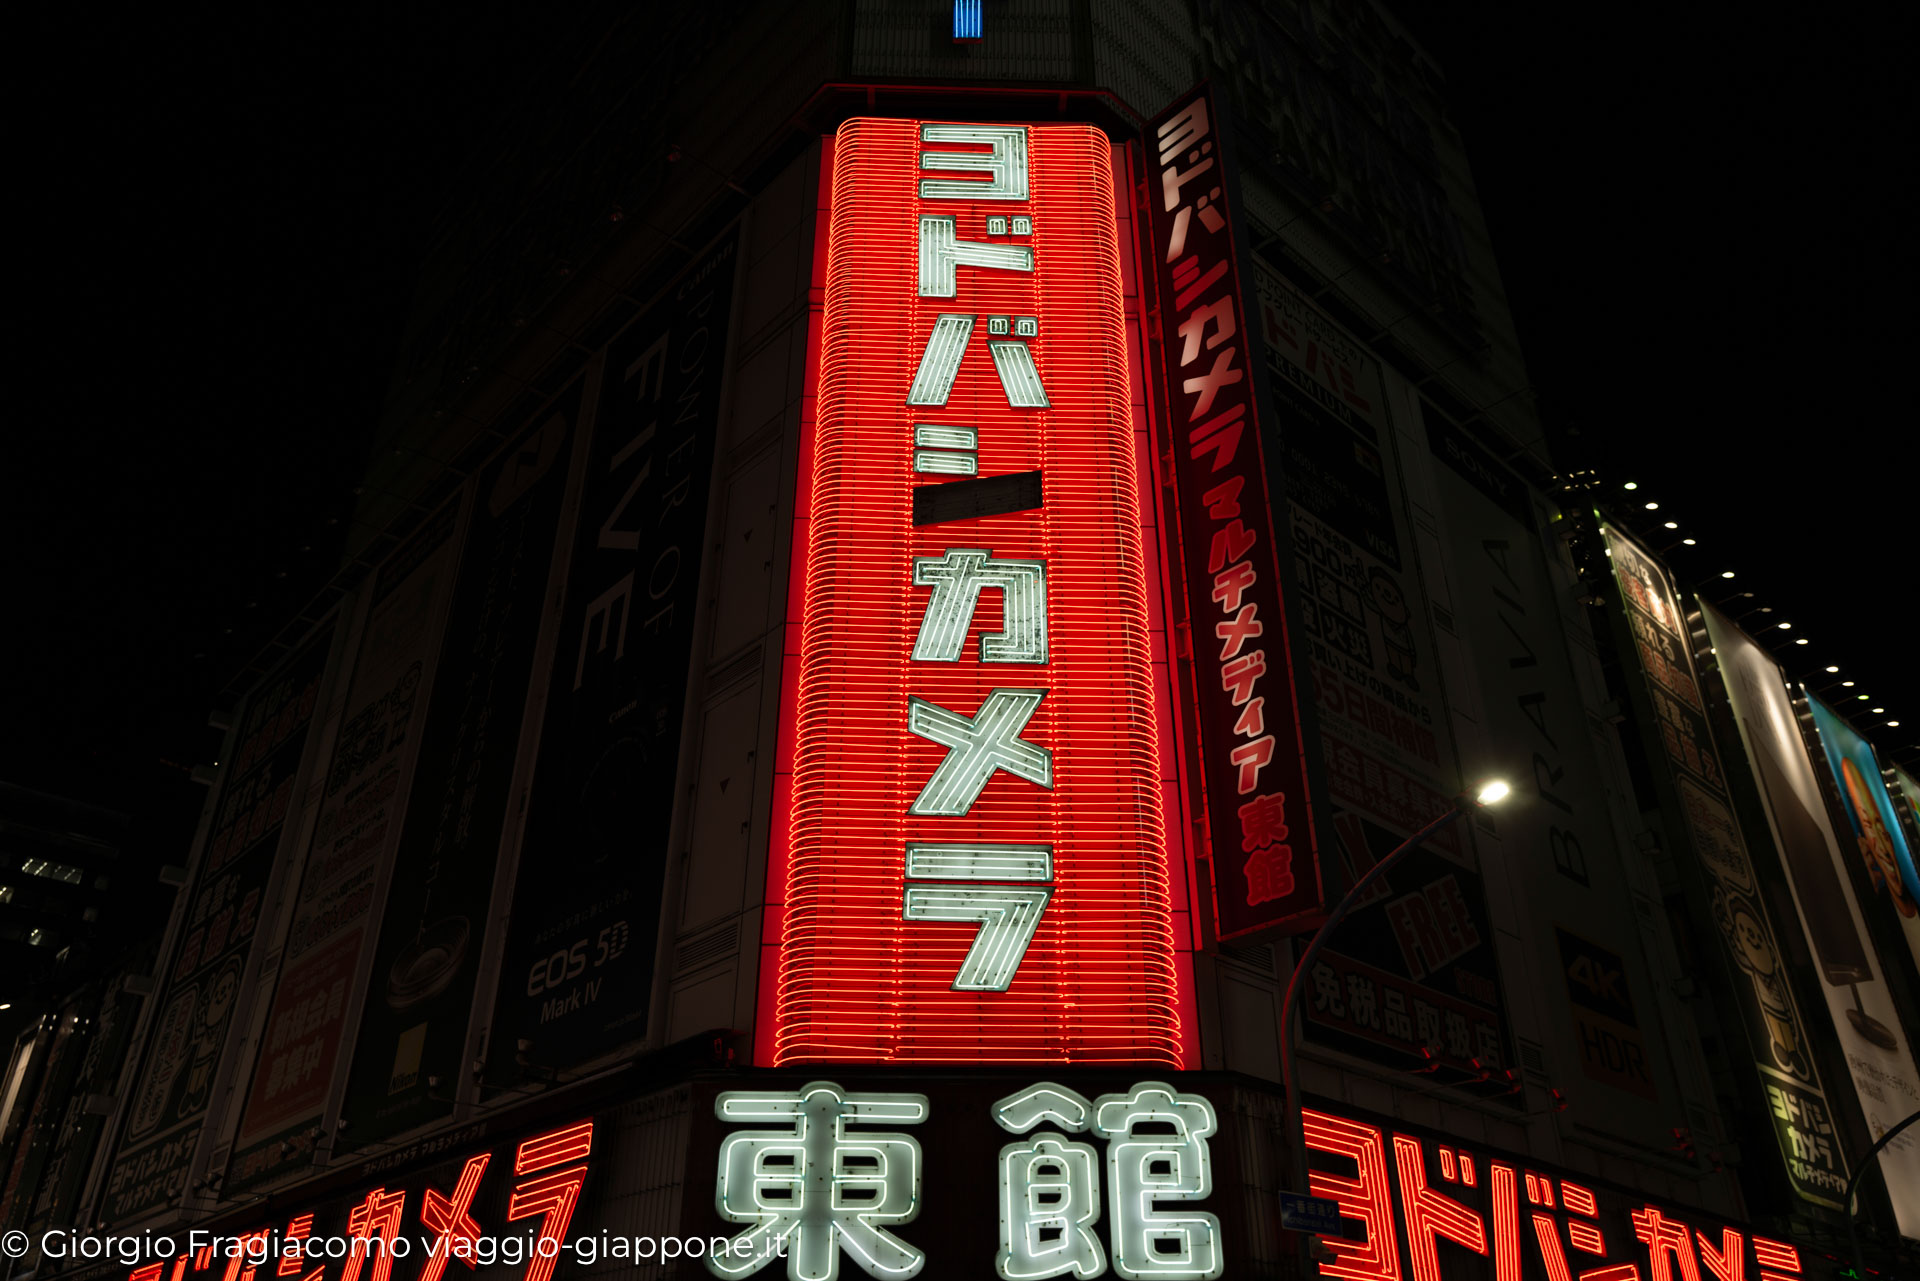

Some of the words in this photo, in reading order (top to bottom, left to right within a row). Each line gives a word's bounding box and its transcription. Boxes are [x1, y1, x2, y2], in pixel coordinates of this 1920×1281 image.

[676, 240, 734, 303] Canon
[1262, 304, 1372, 414] ドバシ
[656, 288, 714, 529] POWER
[1157, 96, 1247, 472] ヨドバシカメラ
[1202, 473, 1275, 796] マルチメディア
[1239, 794, 1296, 908] 東館
[1444, 435, 1505, 494] SONY
[571, 328, 672, 696] FIVE
[1366, 530, 1395, 562] VISA
[641, 545, 681, 635] OF
[902, 124, 1054, 993] ヨドバシカメラ
[1482, 539, 1591, 889] BRAVIA
[527, 937, 591, 998] EOS
[594, 919, 630, 969] 5D
[1383, 873, 1482, 983] FREE
[540, 988, 581, 1024] Mark
[584, 977, 603, 1007] IV
[1313, 961, 1501, 1071] 免税品取扱店
[1567, 950, 1627, 1005] 4K
[1579, 1019, 1650, 1085] HDR
[1766, 1083, 1833, 1137] ヨドバシ
[1788, 1125, 1835, 1170] カメラ
[111, 1127, 199, 1184] ヨドバシカメラ
[703, 1081, 1224, 1281] 東館
